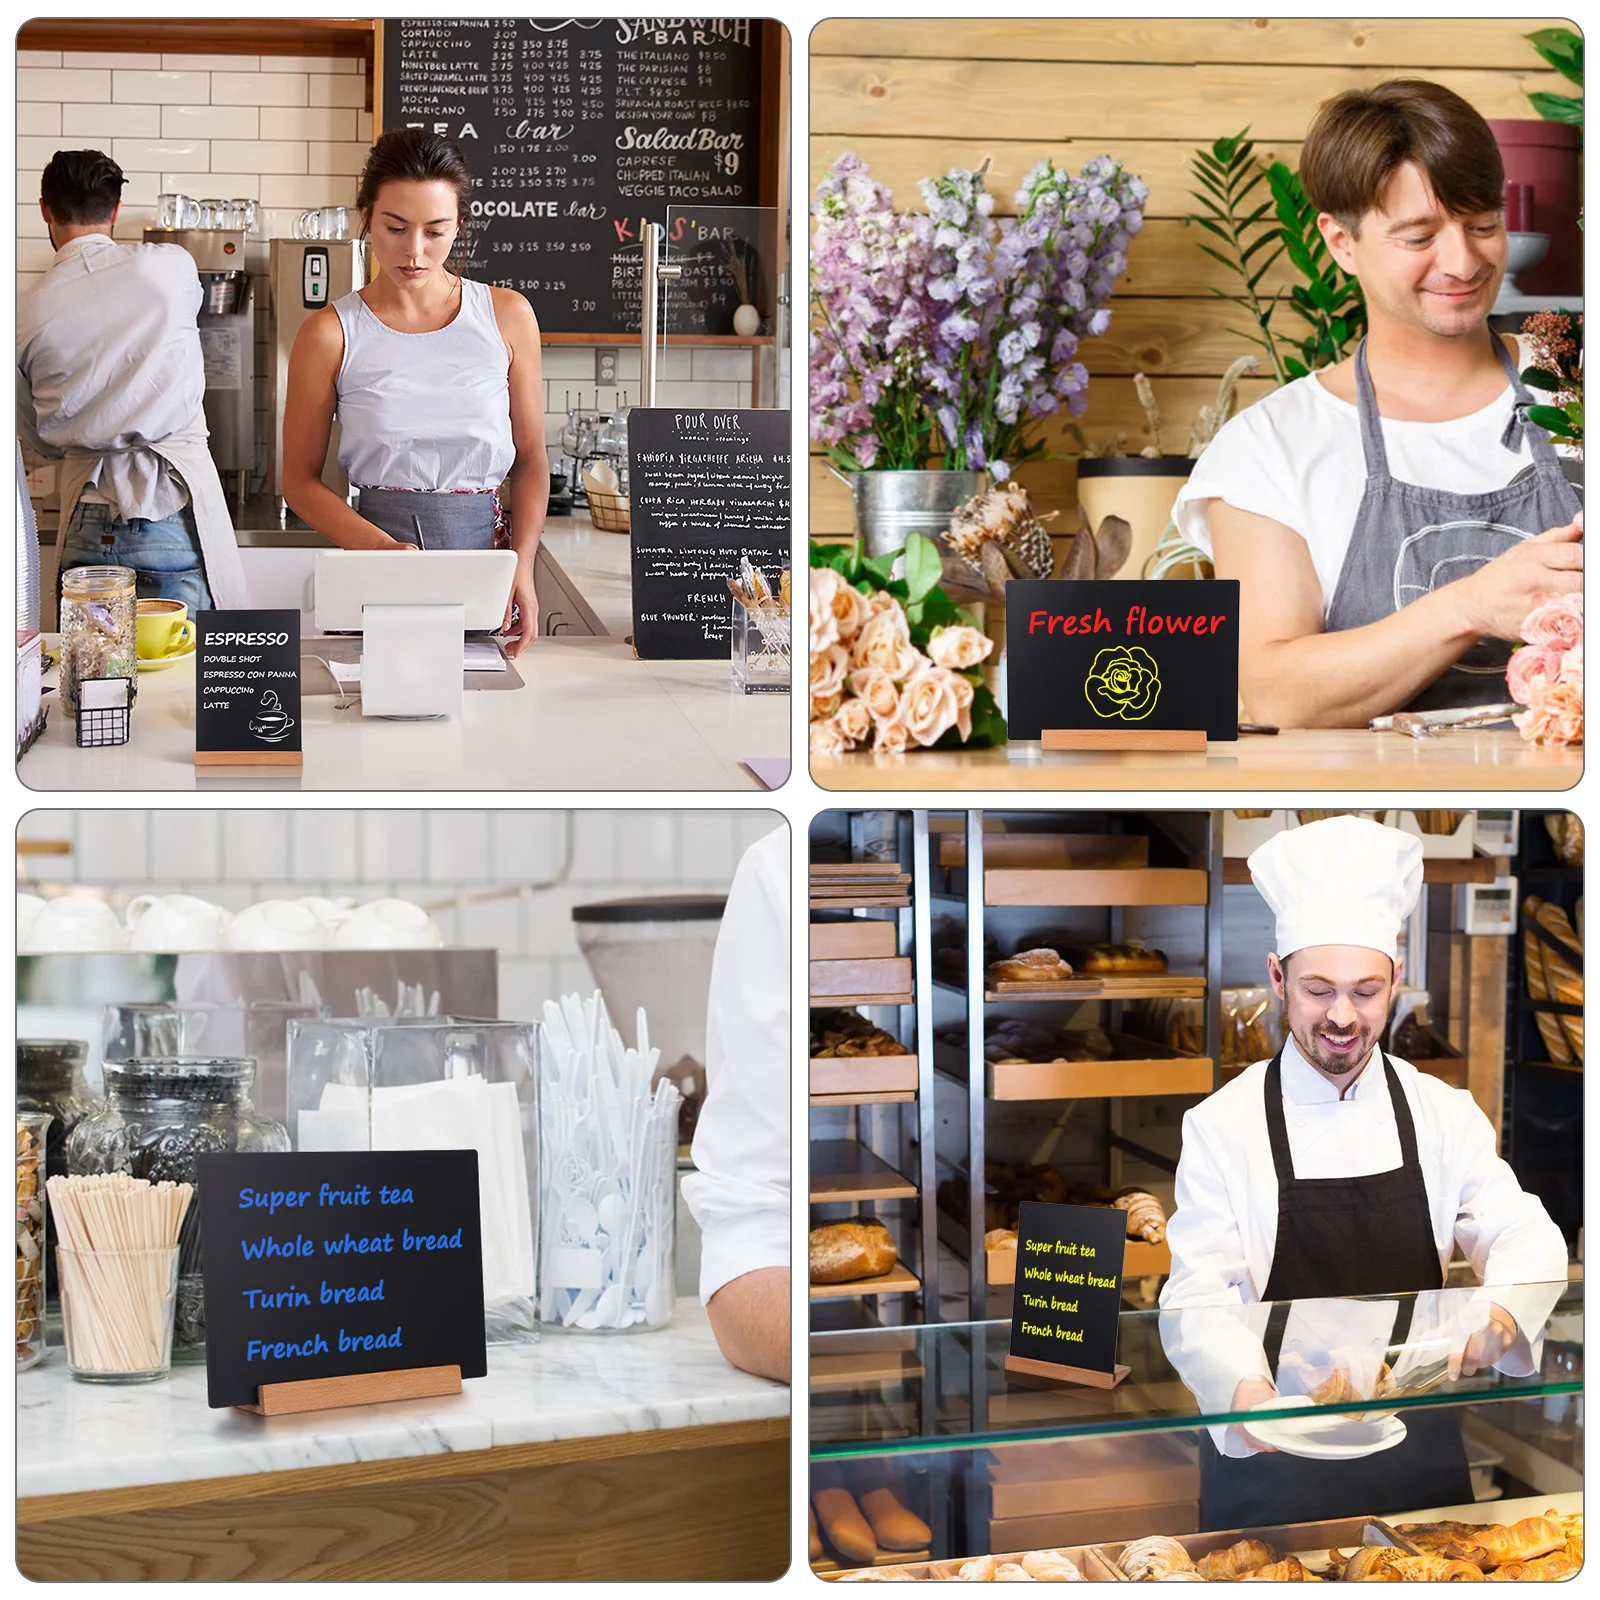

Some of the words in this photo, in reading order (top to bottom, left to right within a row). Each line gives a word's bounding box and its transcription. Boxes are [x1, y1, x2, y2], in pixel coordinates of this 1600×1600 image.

[401, 29, 451, 38] CORTADO
[655, 30, 716, 46] BAR
[401, 40, 471, 48] CAPPUCCINO
[402, 50, 438, 59] LATTE
[616, 50, 637, 60] THE
[640, 51, 690, 61] ITALIANO
[450, 62, 479, 71] LATTE
[617, 64, 636, 73] THE
[640, 64, 689, 74] PARISIAN
[617, 76, 636, 86] THE
[640, 76, 688, 86] CAPRESE
[401, 96, 438, 104] MOCHA
[615, 99, 661, 109] SRIRACHA
[664, 99, 697, 110] ROAST
[401, 105, 465, 115] AMERICANO
[615, 111, 649, 120] DESIGN
[616, 155, 677, 167] CAPRESE
[616, 169, 665, 181] CHOPPED
[669, 169, 710, 182] ITALIAN
[618, 184, 665, 197] VEGGIE
[668, 185, 700, 197] TACO
[701, 184, 743, 197] SALAD
[471, 201, 558, 217] OCOLATE
[698, 226, 734, 241] BAR
[675, 412, 707, 430] POUR
[713, 414, 741, 430] OVER
[687, 593, 726, 603] FRENCH
[640, 613, 658, 621] BLUE
[1028, 607, 1112, 635] Fresh
[1126, 605, 1227, 635] flower
[204, 632, 289, 646] ESPRESSO
[238, 655, 262, 663] SHOT
[203, 671, 245, 679] ESPRESSO
[247, 671, 265, 679] CON
[267, 671, 297, 679] PANNA
[238, 1187, 312, 1215] Super
[319, 1183, 371, 1207] fruit
[379, 1185, 414, 1204] tea
[241, 1234, 314, 1260] Whole
[324, 1233, 394, 1256] wheat
[402, 1228, 463, 1251] bread
[1025, 1239, 1053, 1256] Super
[1055, 1240, 1077, 1256] fruit
[1080, 1244, 1096, 1258] tea
[1024, 1267, 1052, 1282] Whole
[1055, 1270, 1085, 1286] wheat
[1088, 1272, 1117, 1289] bread
[242, 1285, 311, 1310] Turin
[320, 1279, 385, 1304] bread
[1023, 1294, 1048, 1309] Turin
[1051, 1296, 1078, 1313] bread
[1021, 1322, 1053, 1337] French
[1056, 1326, 1083, 1343] bread
[247, 1333, 329, 1361] French
[338, 1326, 403, 1352] bread
